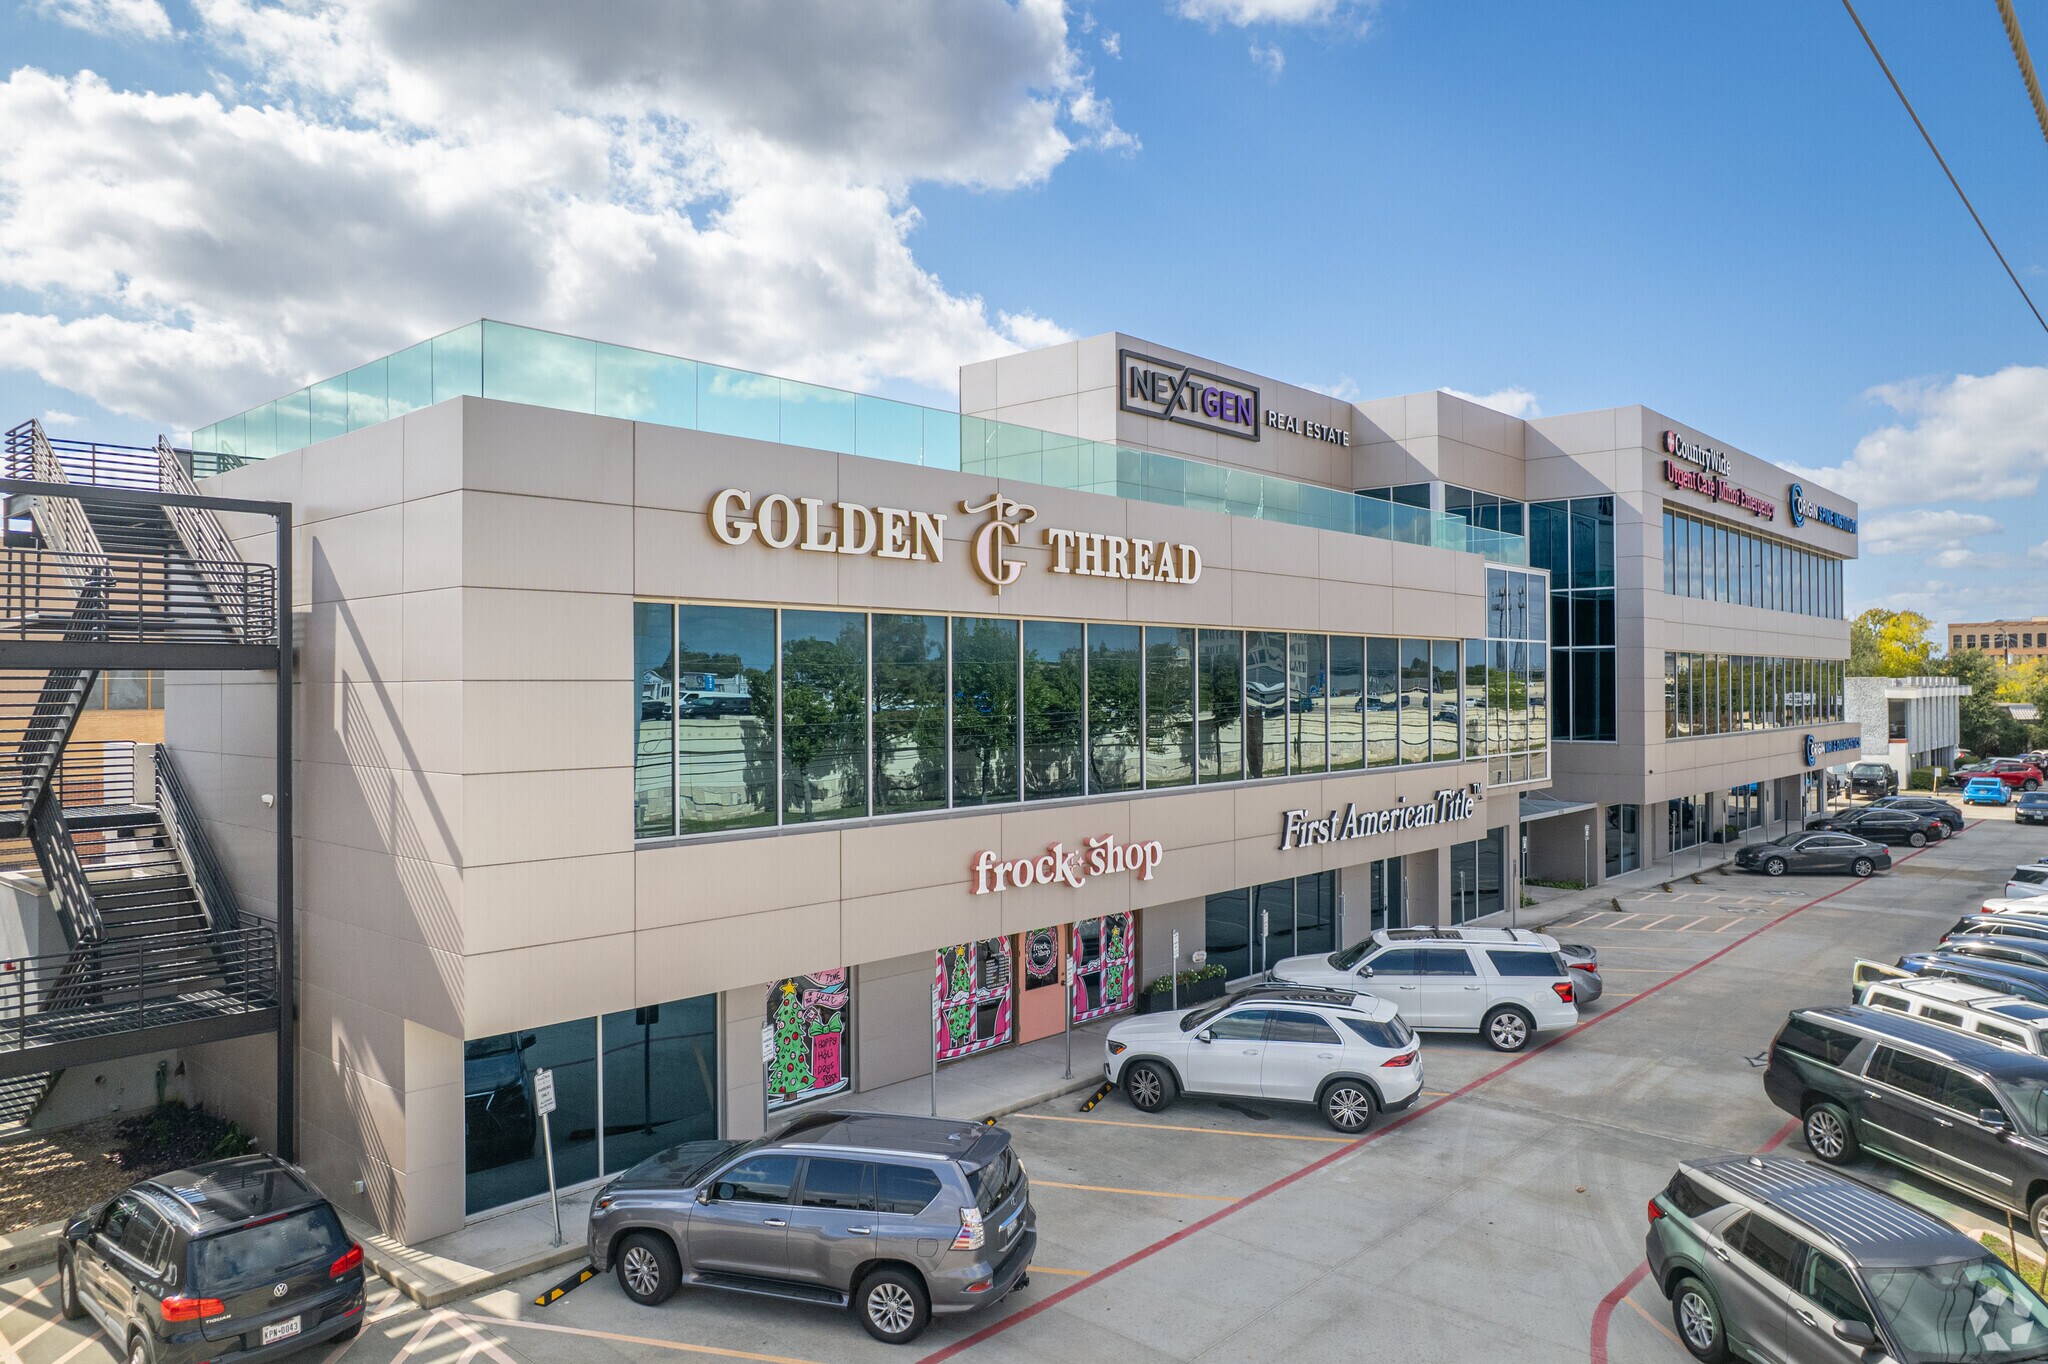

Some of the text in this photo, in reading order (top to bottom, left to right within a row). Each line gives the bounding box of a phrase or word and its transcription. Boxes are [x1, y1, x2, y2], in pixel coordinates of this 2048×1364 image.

[1130, 365, 1253, 427] NEXTGEN
[1266, 409, 1350, 448] REAL ESTATE
[1675, 432, 1732, 477] CountryWide
[1665, 460, 1775, 519] Urgent Care Minor Emergency
[707, 487, 948, 564] GOLDEN
[1043, 527, 1203, 586] THREAD
[1280, 809, 1340, 851] First
[1338, 795, 1436, 841] American
[1434, 787, 1475, 825] Title
[970, 832, 1164, 896] frock shop
[205, 1313, 232, 1325] TIGUAN
